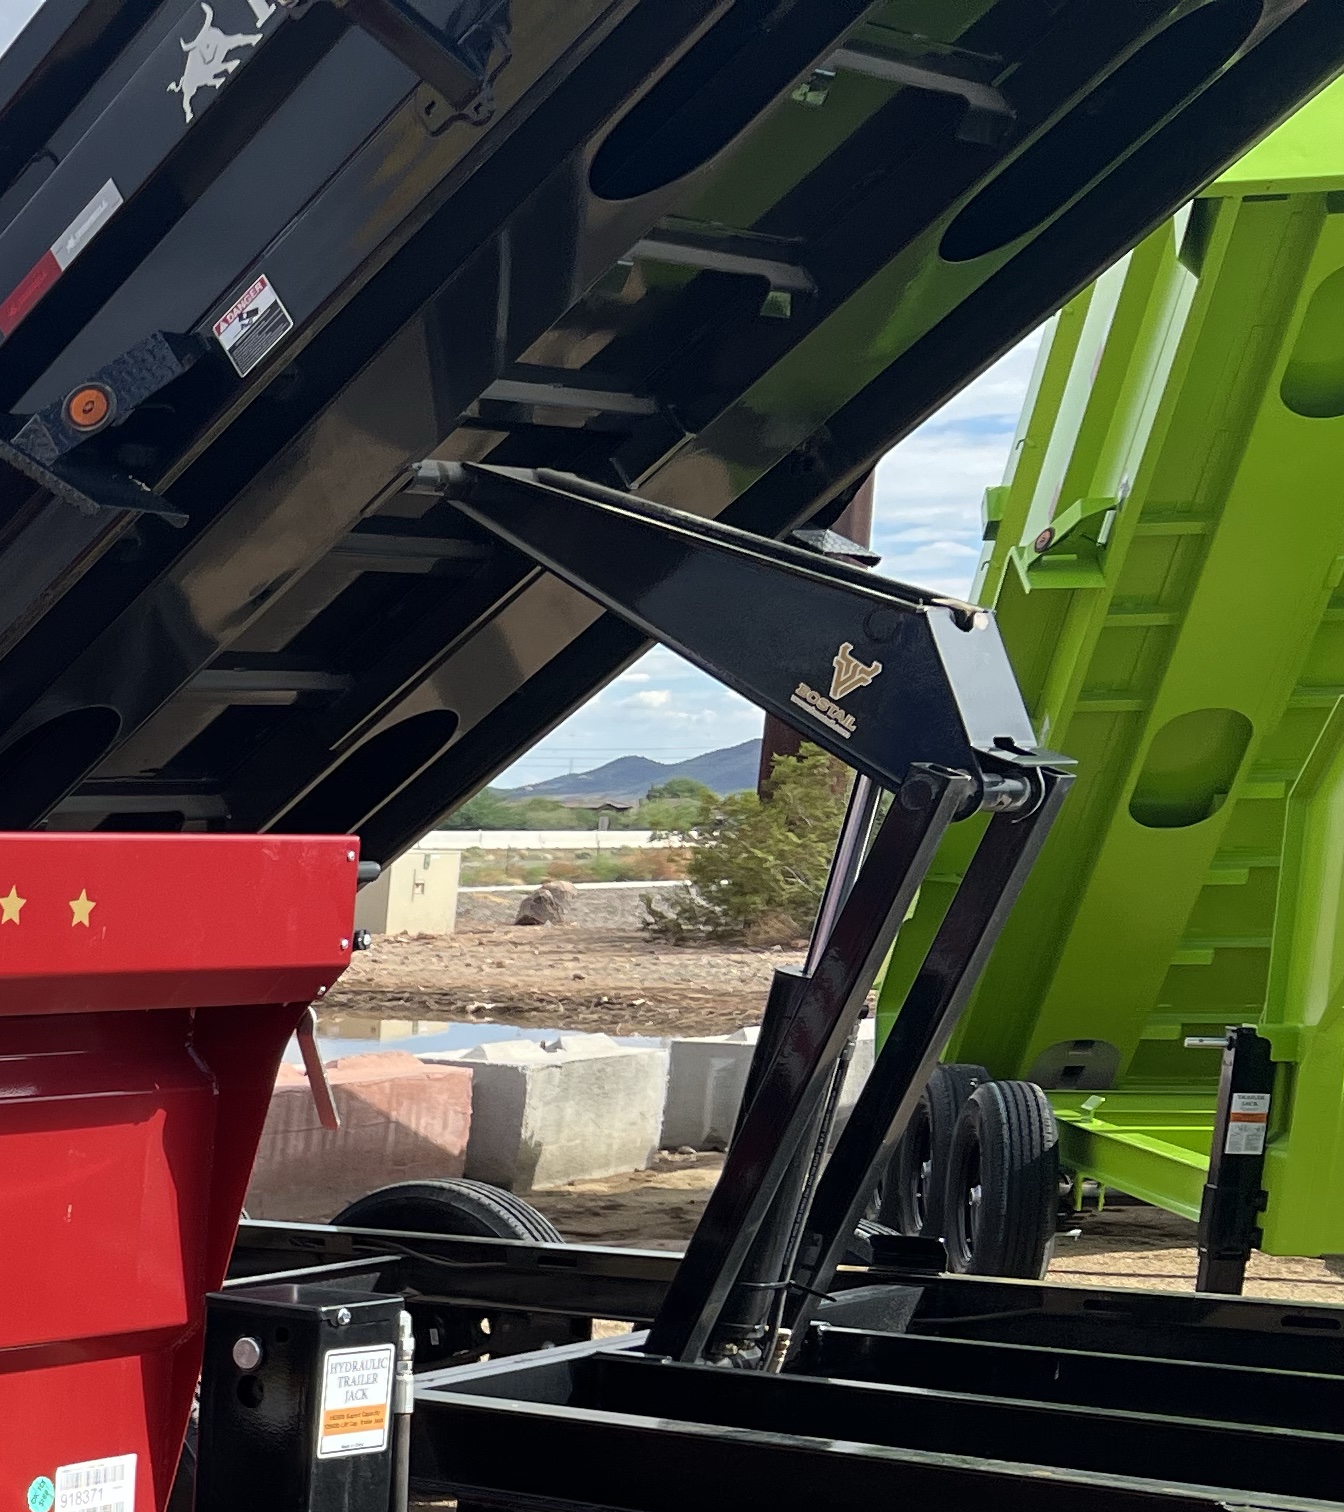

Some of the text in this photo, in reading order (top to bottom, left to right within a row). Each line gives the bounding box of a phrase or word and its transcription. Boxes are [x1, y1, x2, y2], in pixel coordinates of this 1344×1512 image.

[226, 280, 265, 321] DANGER
[794, 682, 857, 732] BOSTAIL
[329, 1357, 389, 1375] HYDRAULIC
[337, 1372, 379, 1389] TRAILER
[344, 1387, 369, 1404] JACK
[60, 1488, 103, 1508] 918371
